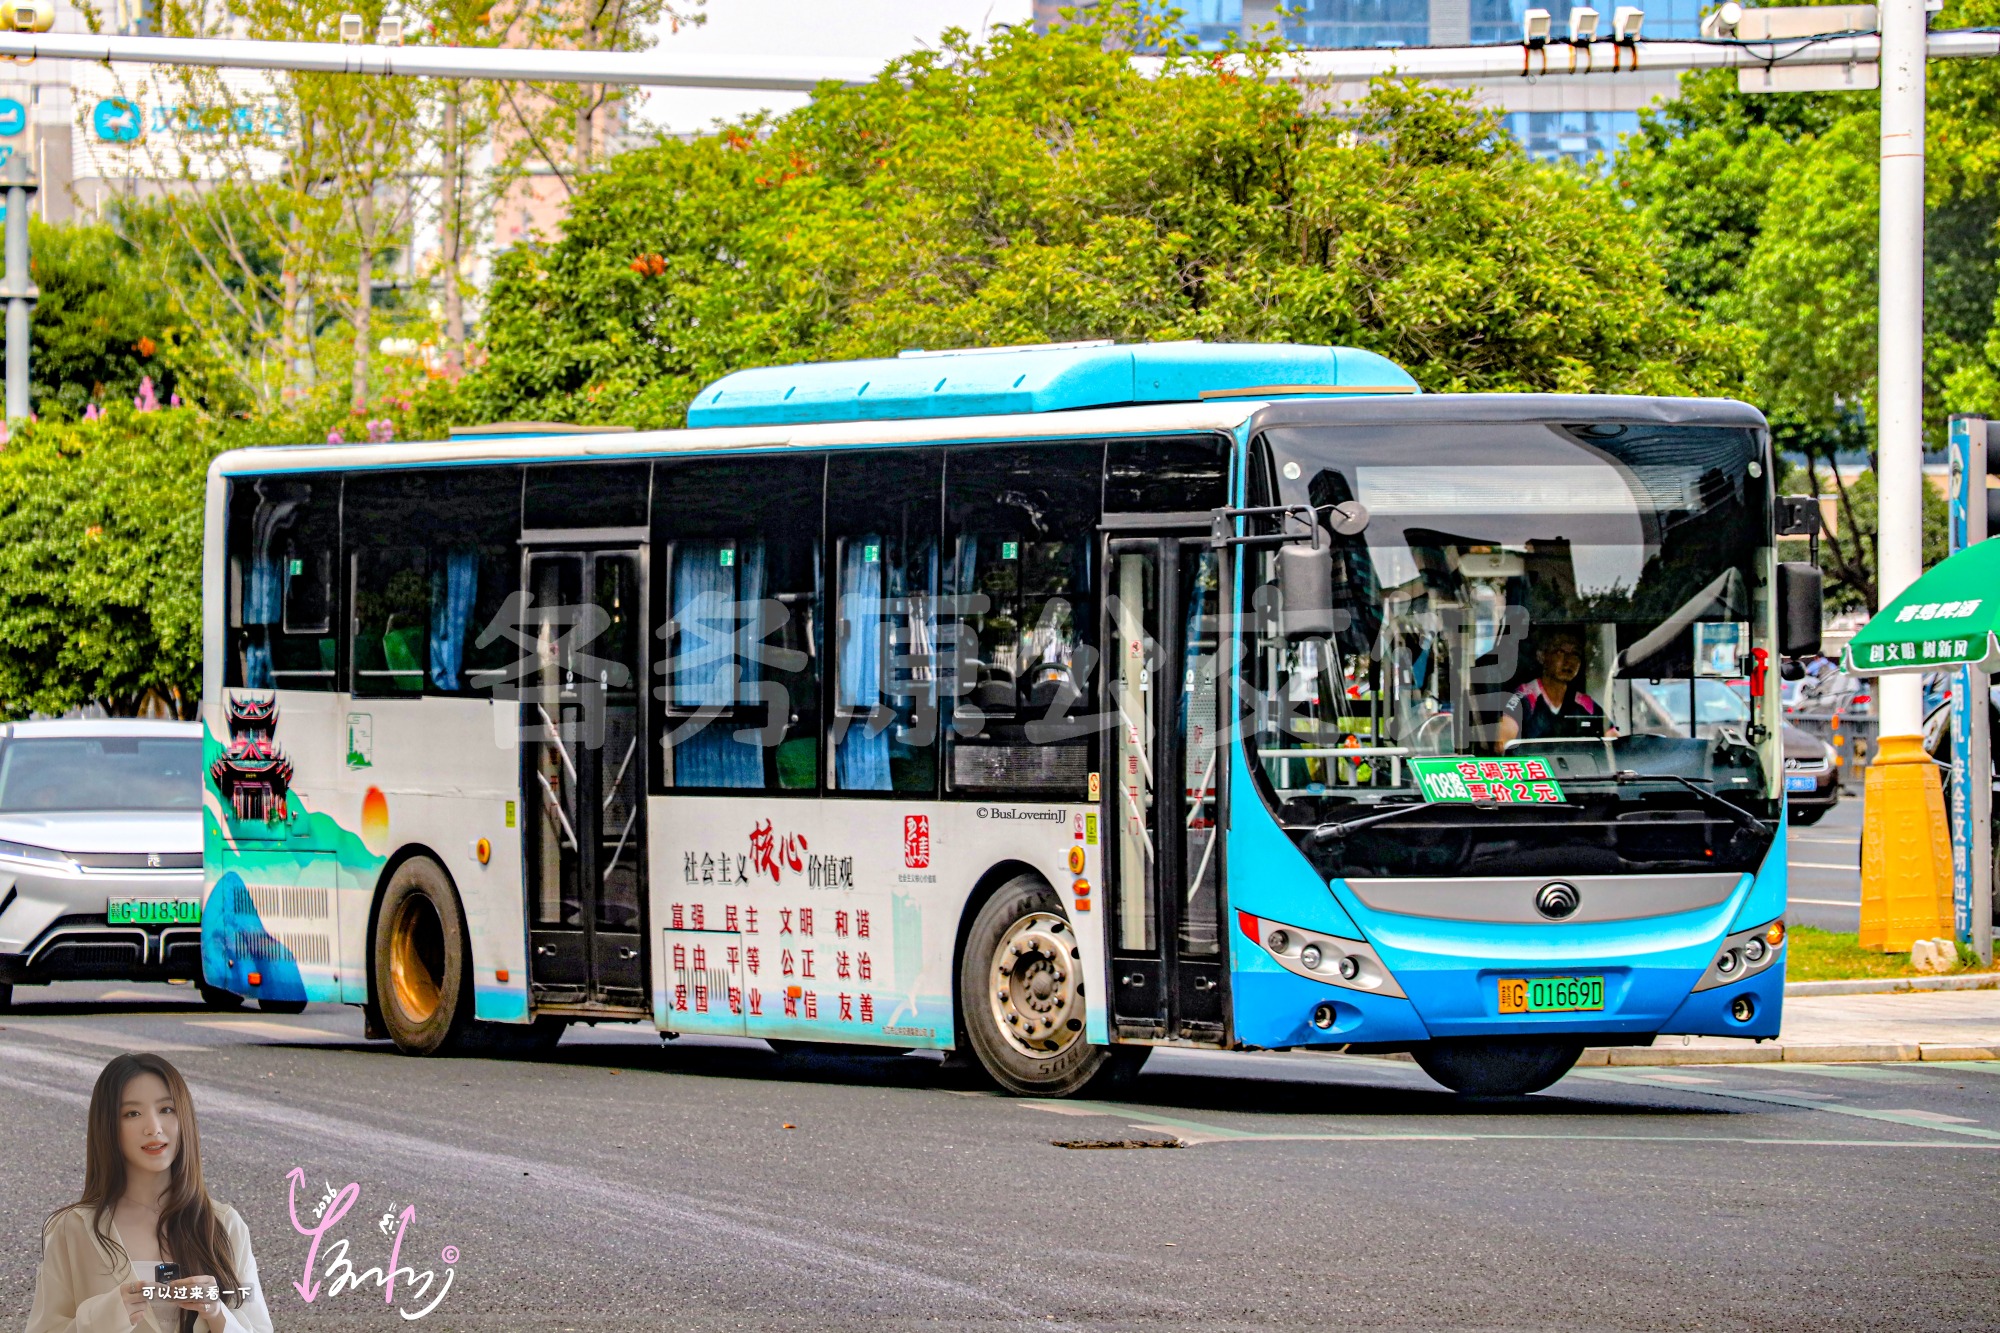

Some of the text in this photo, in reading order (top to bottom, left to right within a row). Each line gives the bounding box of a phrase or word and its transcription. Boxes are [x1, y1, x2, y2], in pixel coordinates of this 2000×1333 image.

[1895, 599, 1983, 623] 青岛啤酒
[1425, 771, 1469, 799] 108路
[1456, 760, 1548, 780] 空调开启
[1467, 783, 1558, 802] 票价2元
[684, 818, 854, 889] 社会主义核心价值观
[671, 902, 870, 938] 富强 民主 文明 和谐
[673, 943, 872, 981] 自由 平等 公正 法治
[675, 984, 874, 1023] 爱国 敬业 诚信 友善
